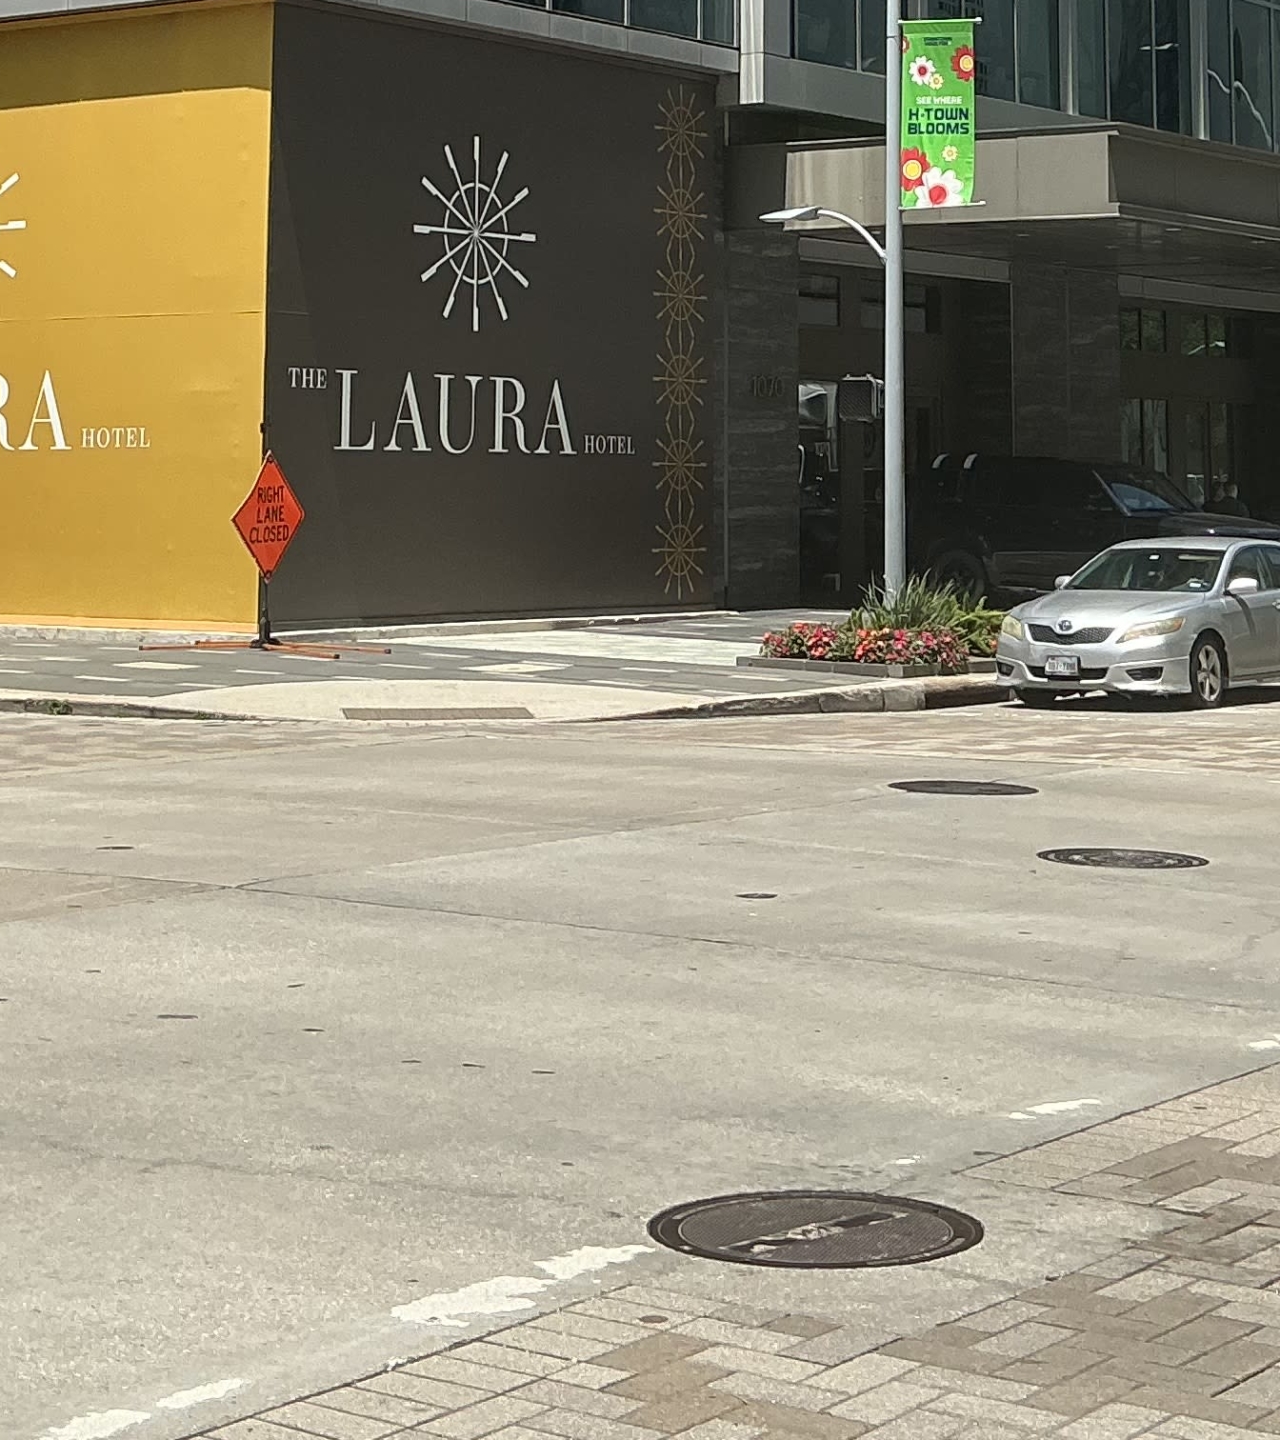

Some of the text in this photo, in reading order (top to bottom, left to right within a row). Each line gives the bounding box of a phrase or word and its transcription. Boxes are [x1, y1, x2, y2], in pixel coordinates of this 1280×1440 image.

[908, 107, 969, 121] H-TOWN
[908, 122, 970, 135] BLOOMS
[752, 375, 785, 397] 1070
[288, 367, 635, 455] THE LAURA HOTEL
[81, 427, 151, 449] HOTEL
[257, 485, 285, 504] RIGHT
[256, 505, 285, 524] LANE
[249, 524, 289, 544] CLOSED
